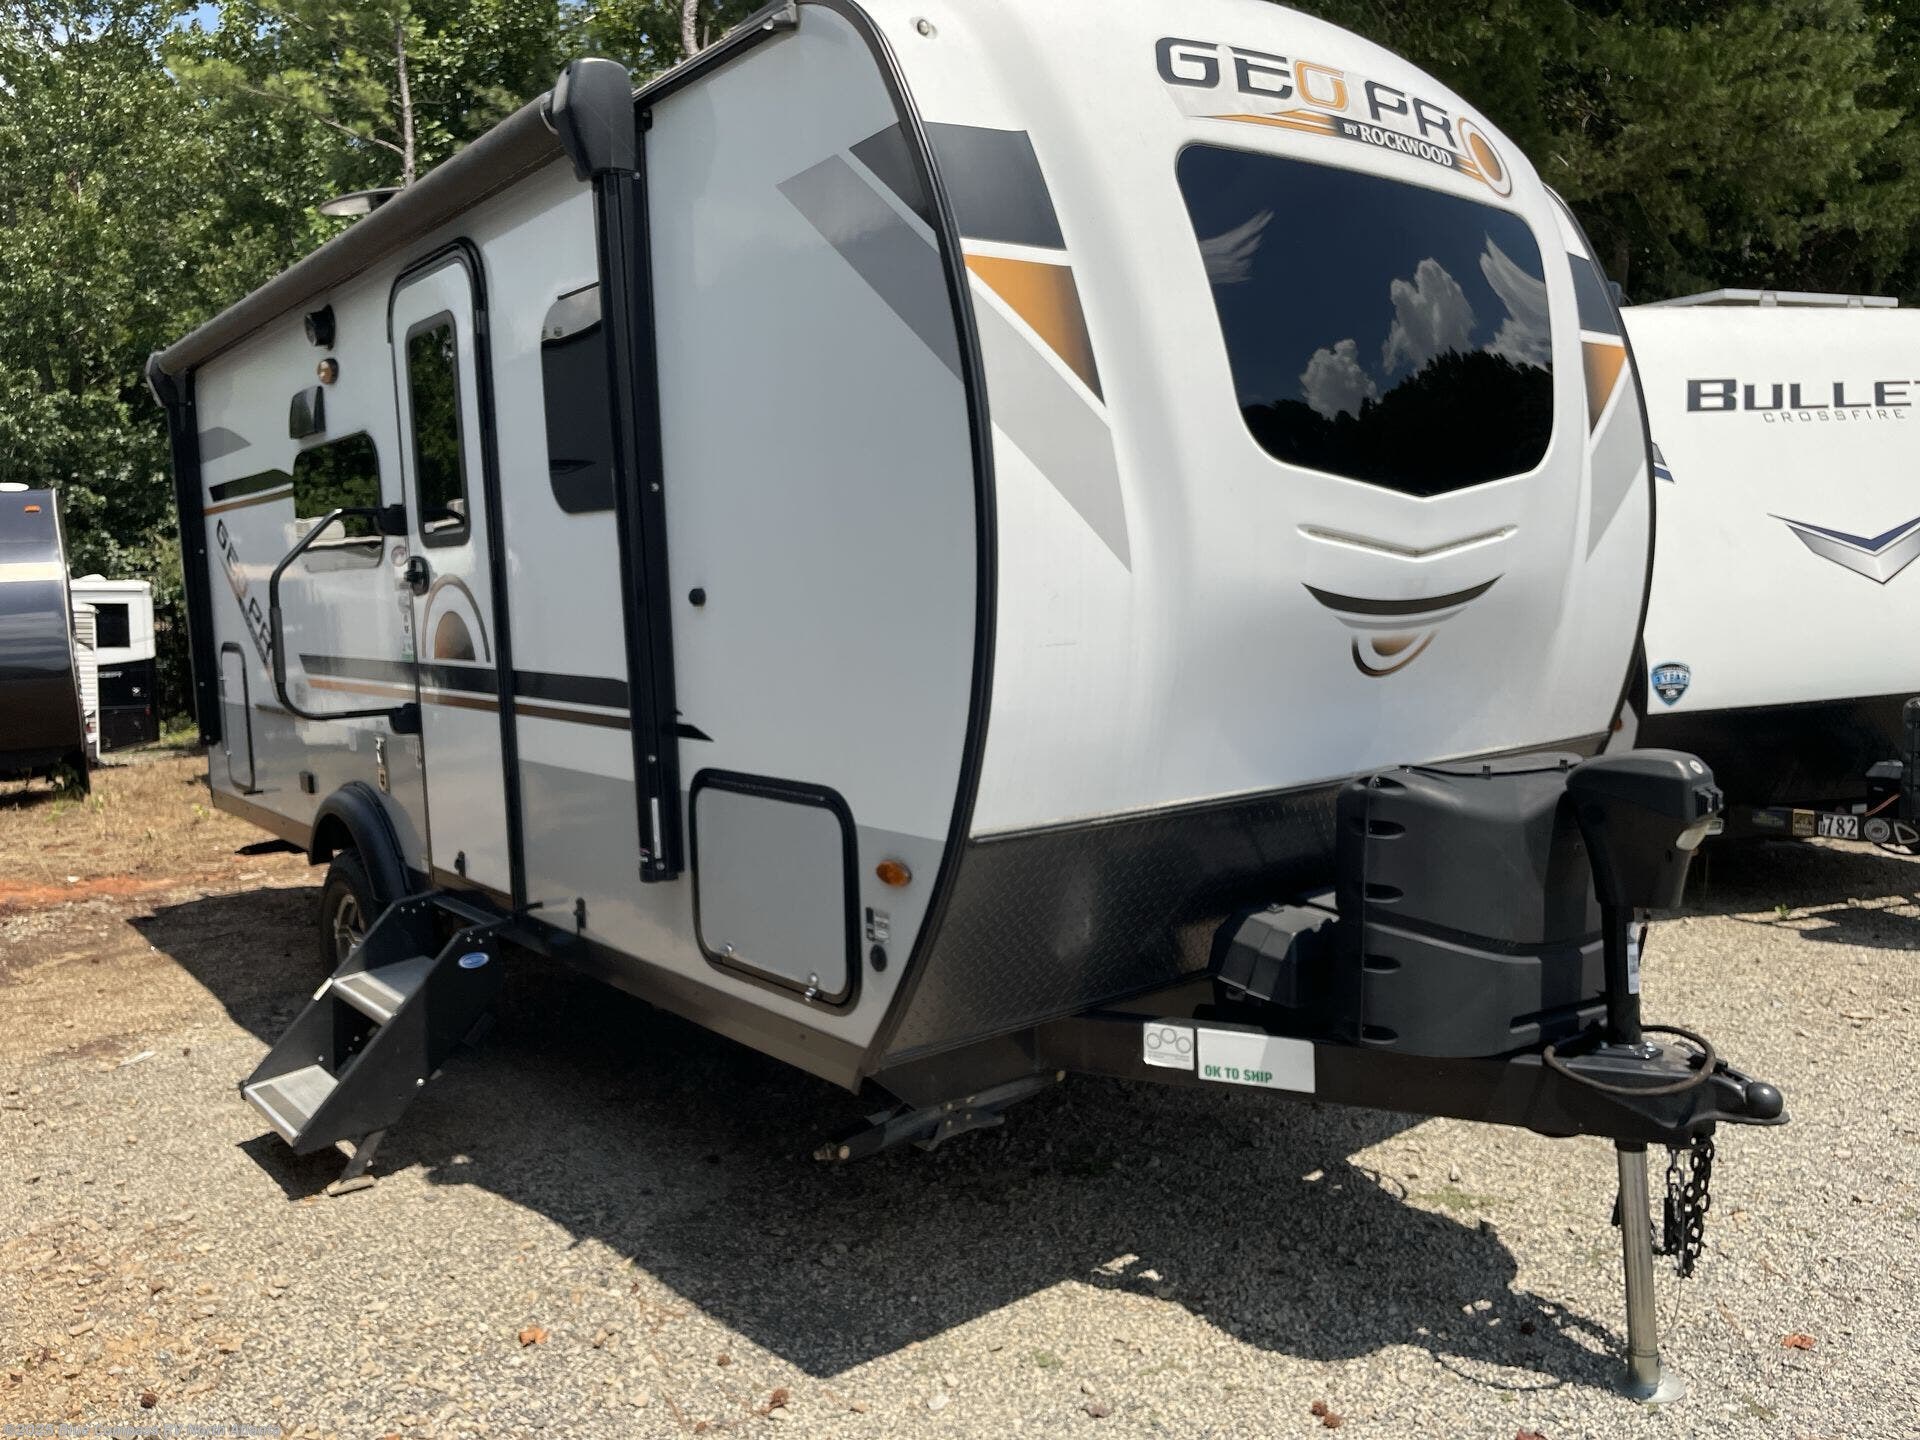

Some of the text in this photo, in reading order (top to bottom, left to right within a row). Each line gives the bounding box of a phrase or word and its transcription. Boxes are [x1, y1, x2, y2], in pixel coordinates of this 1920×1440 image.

[1155, 36, 1350, 113] GEO
[1343, 122, 1453, 167] BY ROCKWOOD
[1686, 378, 1920, 412] BULLE
[1762, 409, 1906, 424] CROSSFIRE
[1204, 1064, 1273, 1084] OK TO SHIP
